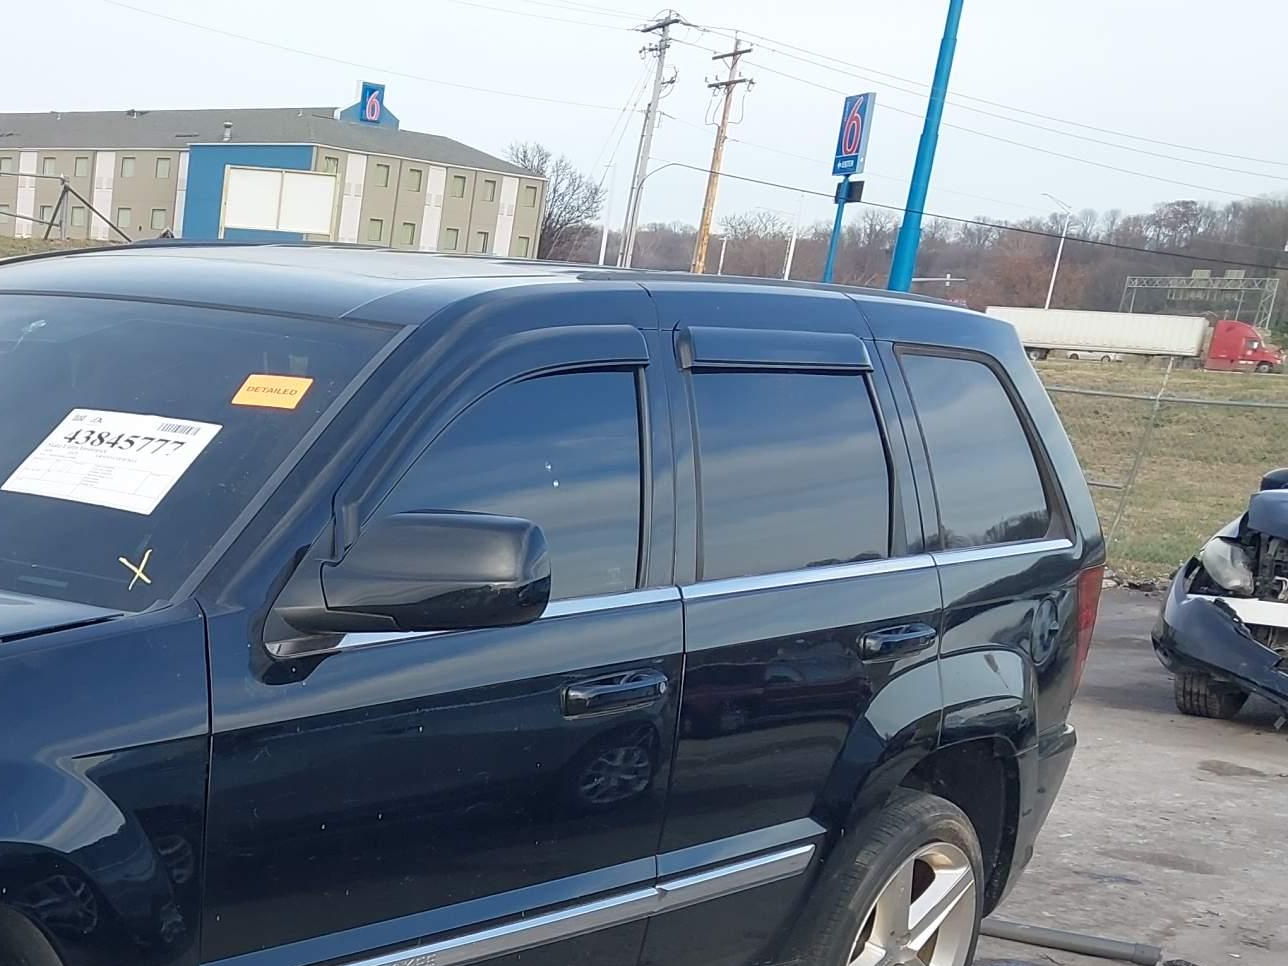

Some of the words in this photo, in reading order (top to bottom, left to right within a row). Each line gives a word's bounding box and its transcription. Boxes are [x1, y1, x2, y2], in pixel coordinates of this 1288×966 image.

[365, 90, 380, 121] 6
[842, 96, 864, 156] 6
[245, 385, 298, 397] DETAILED
[64, 428, 187, 456] 43845777
